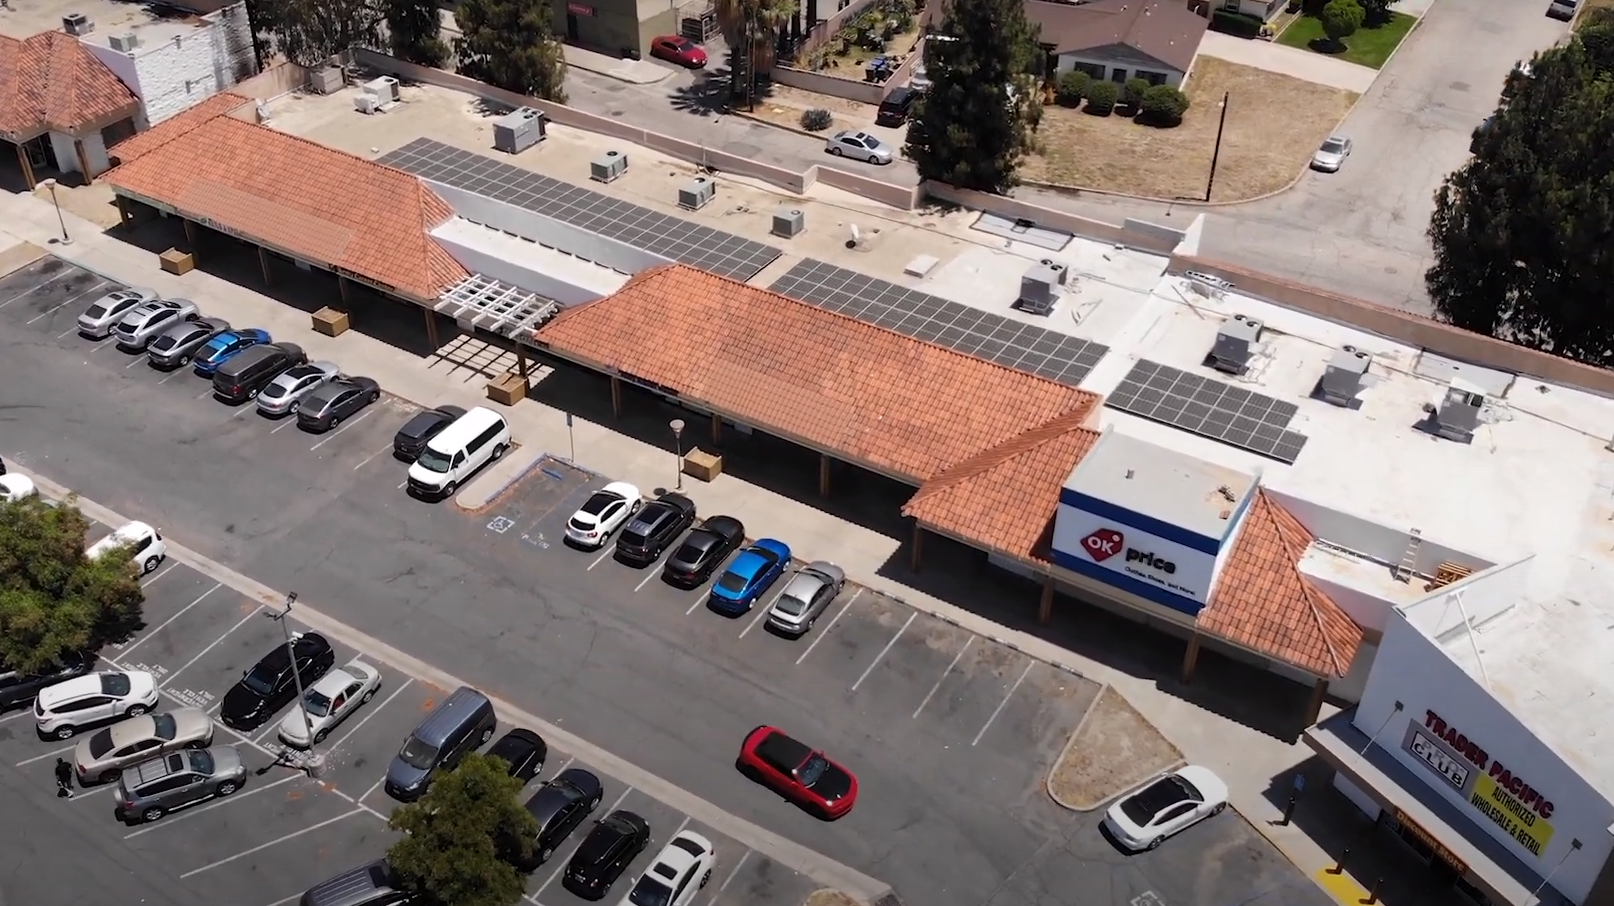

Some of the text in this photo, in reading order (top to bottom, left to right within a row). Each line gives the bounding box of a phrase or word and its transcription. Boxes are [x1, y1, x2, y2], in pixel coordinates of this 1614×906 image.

[1087, 536, 1114, 555] OK
[1125, 547, 1176, 574] price
[1414, 742, 1463, 785] CLUB
[1424, 709, 1555, 819] TRADER PACIFIC
[1470, 792, 1542, 857] WHOLESALE & RETAIL
[1491, 786, 1536, 828] AUTHORIZED
[1396, 810, 1465, 872] Discount Store
